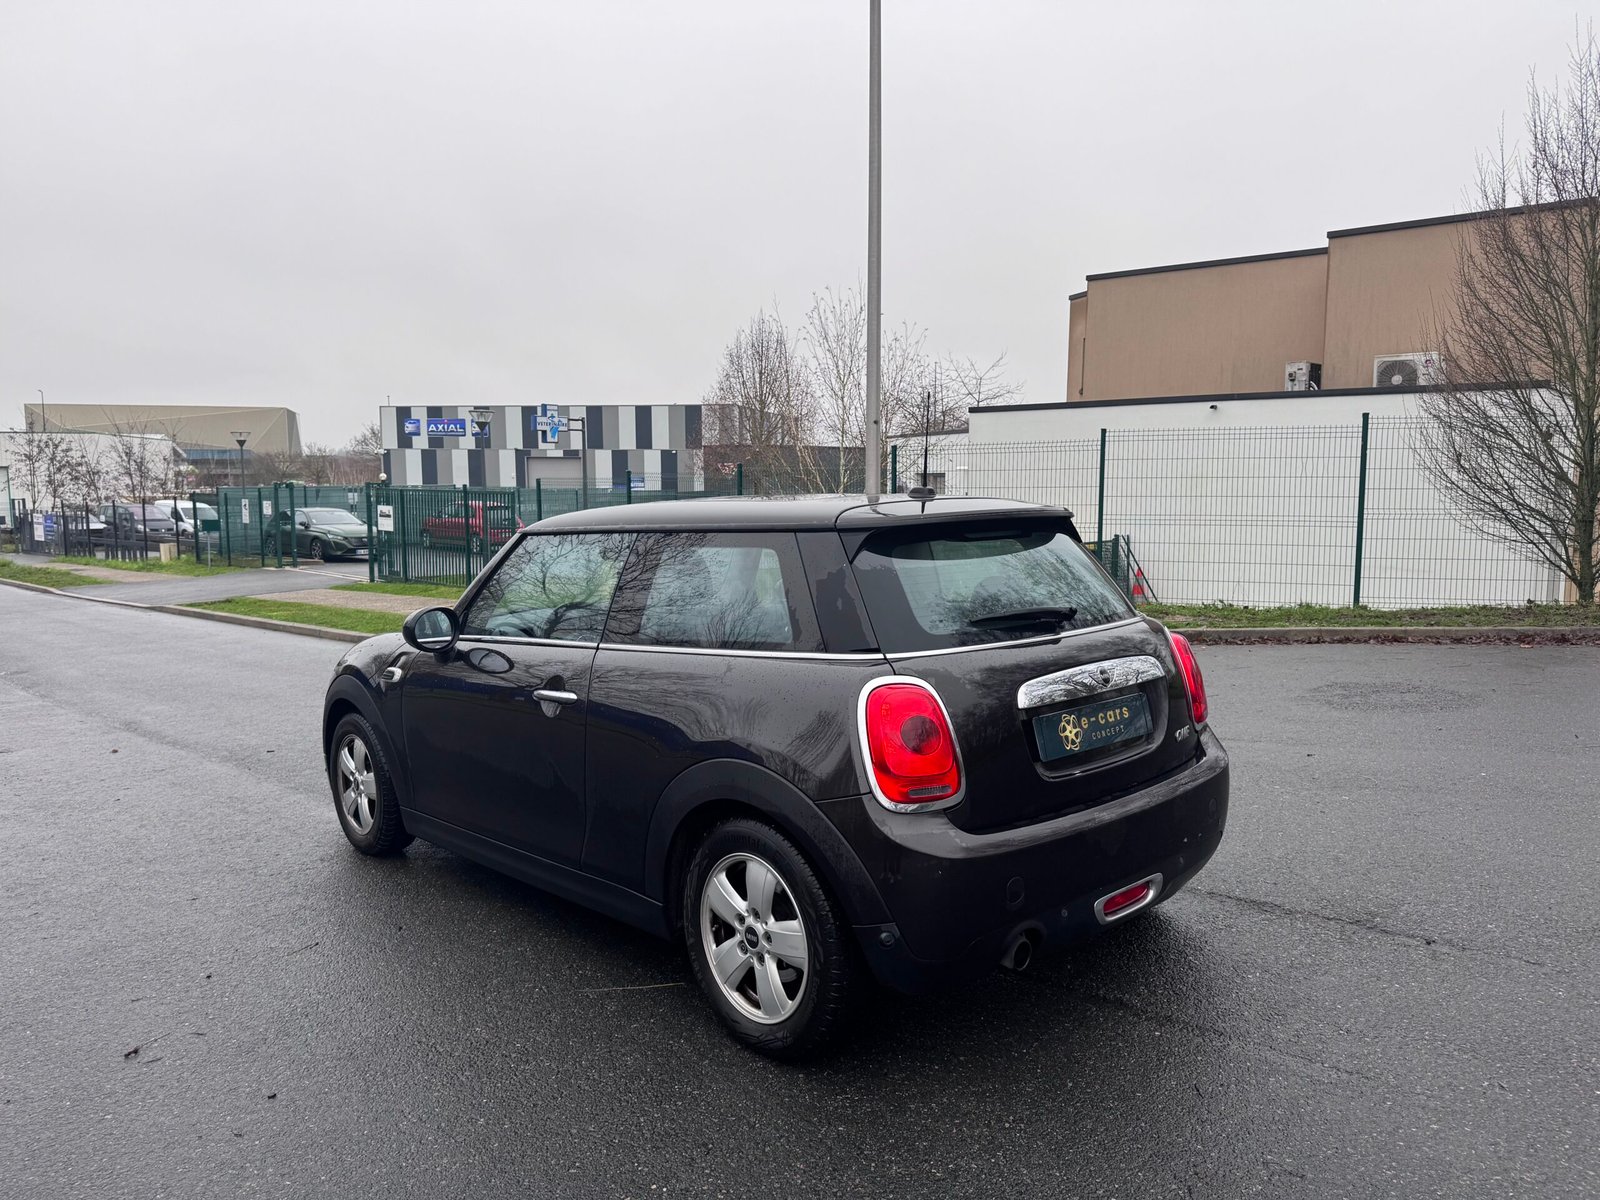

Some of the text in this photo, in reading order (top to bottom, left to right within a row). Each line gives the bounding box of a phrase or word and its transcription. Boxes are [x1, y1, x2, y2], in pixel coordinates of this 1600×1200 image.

[428, 424, 464, 432] AXIAL
[1081, 707, 1130, 728] e-cars
[1091, 725, 1125, 740] CONCEPT
